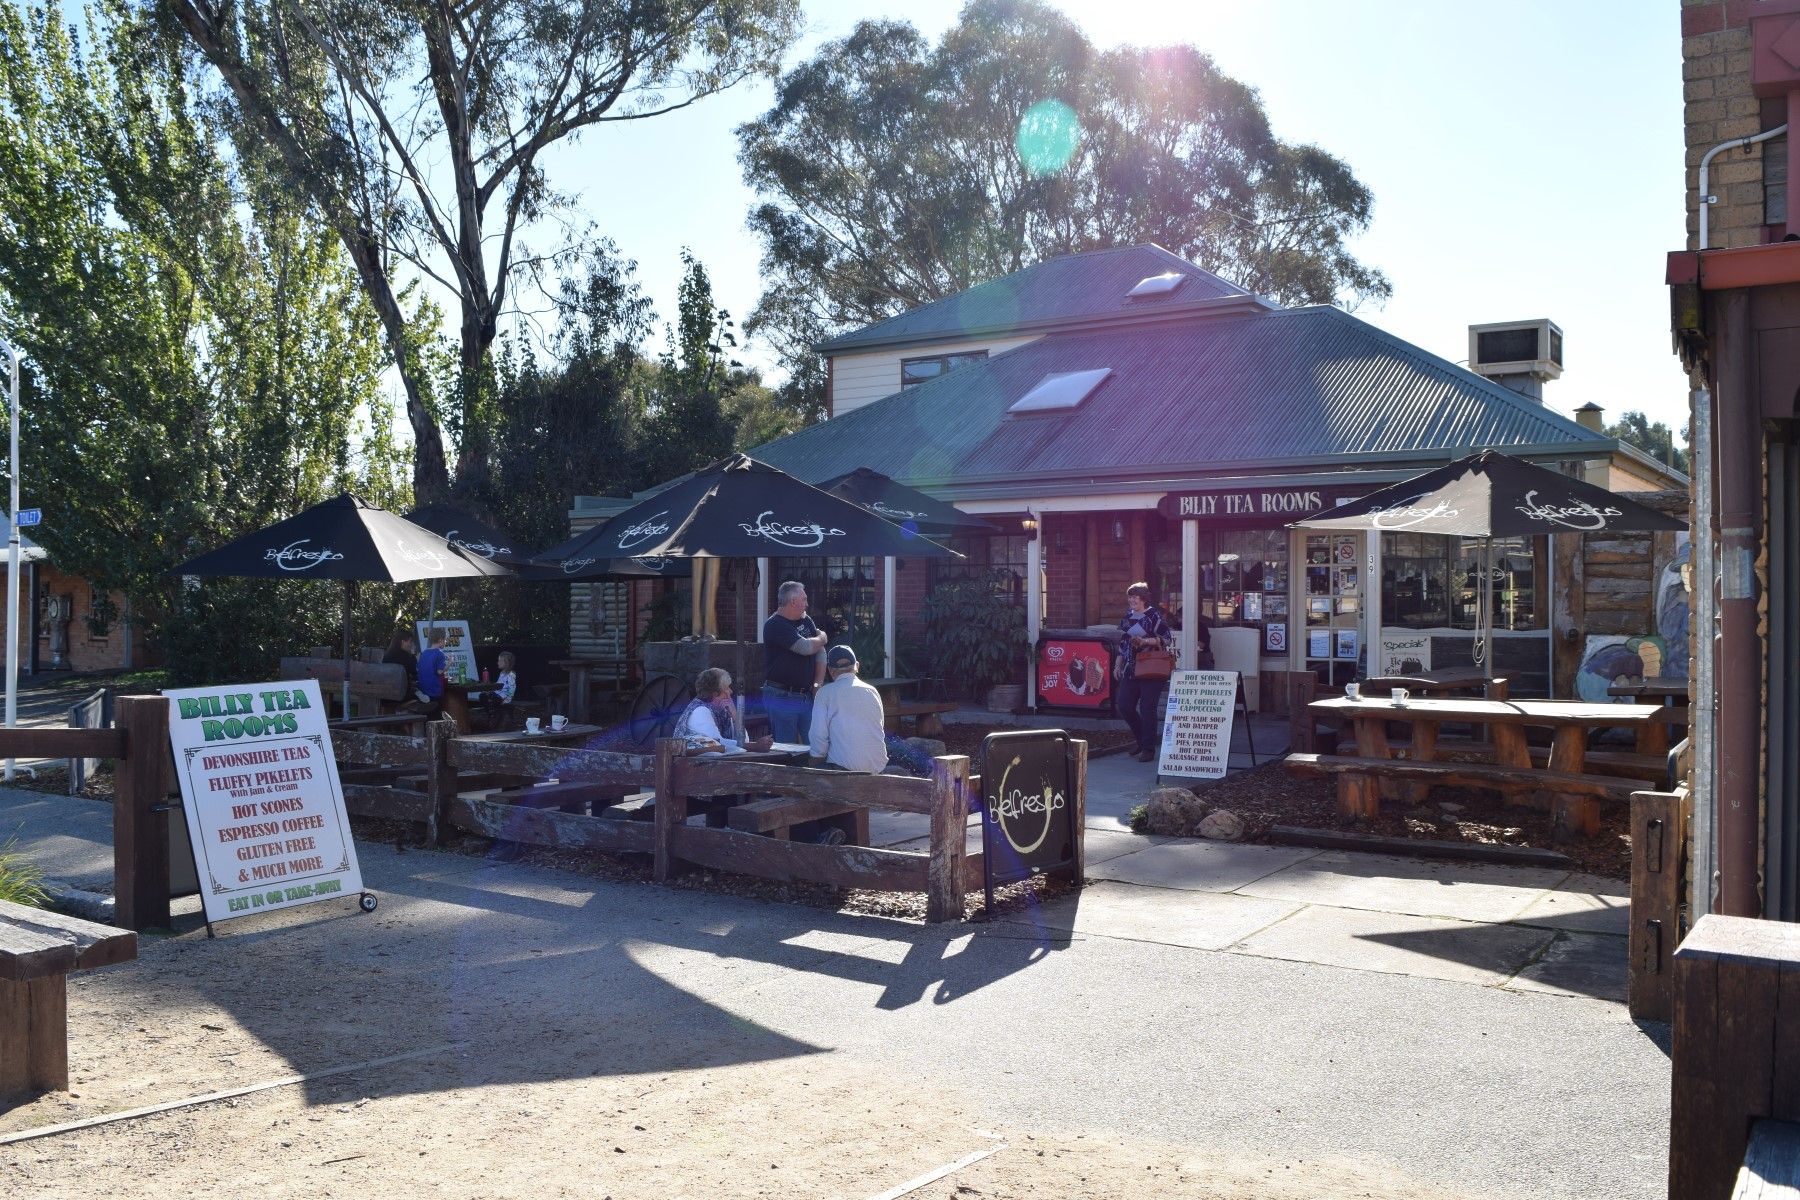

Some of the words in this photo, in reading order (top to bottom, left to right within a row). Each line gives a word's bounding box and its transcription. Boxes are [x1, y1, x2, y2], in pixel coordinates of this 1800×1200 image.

[1179, 495, 1218, 516] BILLY
[1223, 494, 1254, 514] TEA
[1261, 491, 1322, 512] ROOMS
[1044, 680, 1058, 688] JOY
[1174, 688, 1199, 696] FLUFFY
[1200, 689, 1232, 697] PIKELETS
[177, 693, 254, 720] BILLY
[260, 689, 312, 713] TEA
[1179, 705, 1222, 713] CAPPUCCINO
[201, 713, 299, 742] ROOMS
[201, 749, 281, 771] DEVONSHIRE
[281, 745, 311, 761] TEAS
[1184, 765, 1224, 774] SANDWICHES
[208, 773, 252, 792] FLUFFY
[255, 766, 313, 786] PIKELETS
[230, 788, 248, 798] With
[249, 787, 265, 797] Jam
[266, 785, 273, 794] &
[274, 783, 298, 792] Cream
[231, 803, 258, 820] HOT
[261, 797, 304, 816] SCONES
[218, 821, 280, 843] ESPRESSO
[282, 814, 325, 833] COFFEE
[236, 841, 284, 861] GLUTEN
[285, 836, 316, 854] FREE
[238, 868, 249, 883] &
[251, 861, 287, 880] MUCH
[288, 855, 324, 874] MORE
[227, 895, 251, 912] EAT
[251, 893, 266, 908] IN
[266, 889, 284, 905] OR
[284, 879, 342, 901] TAKE-AWAY
